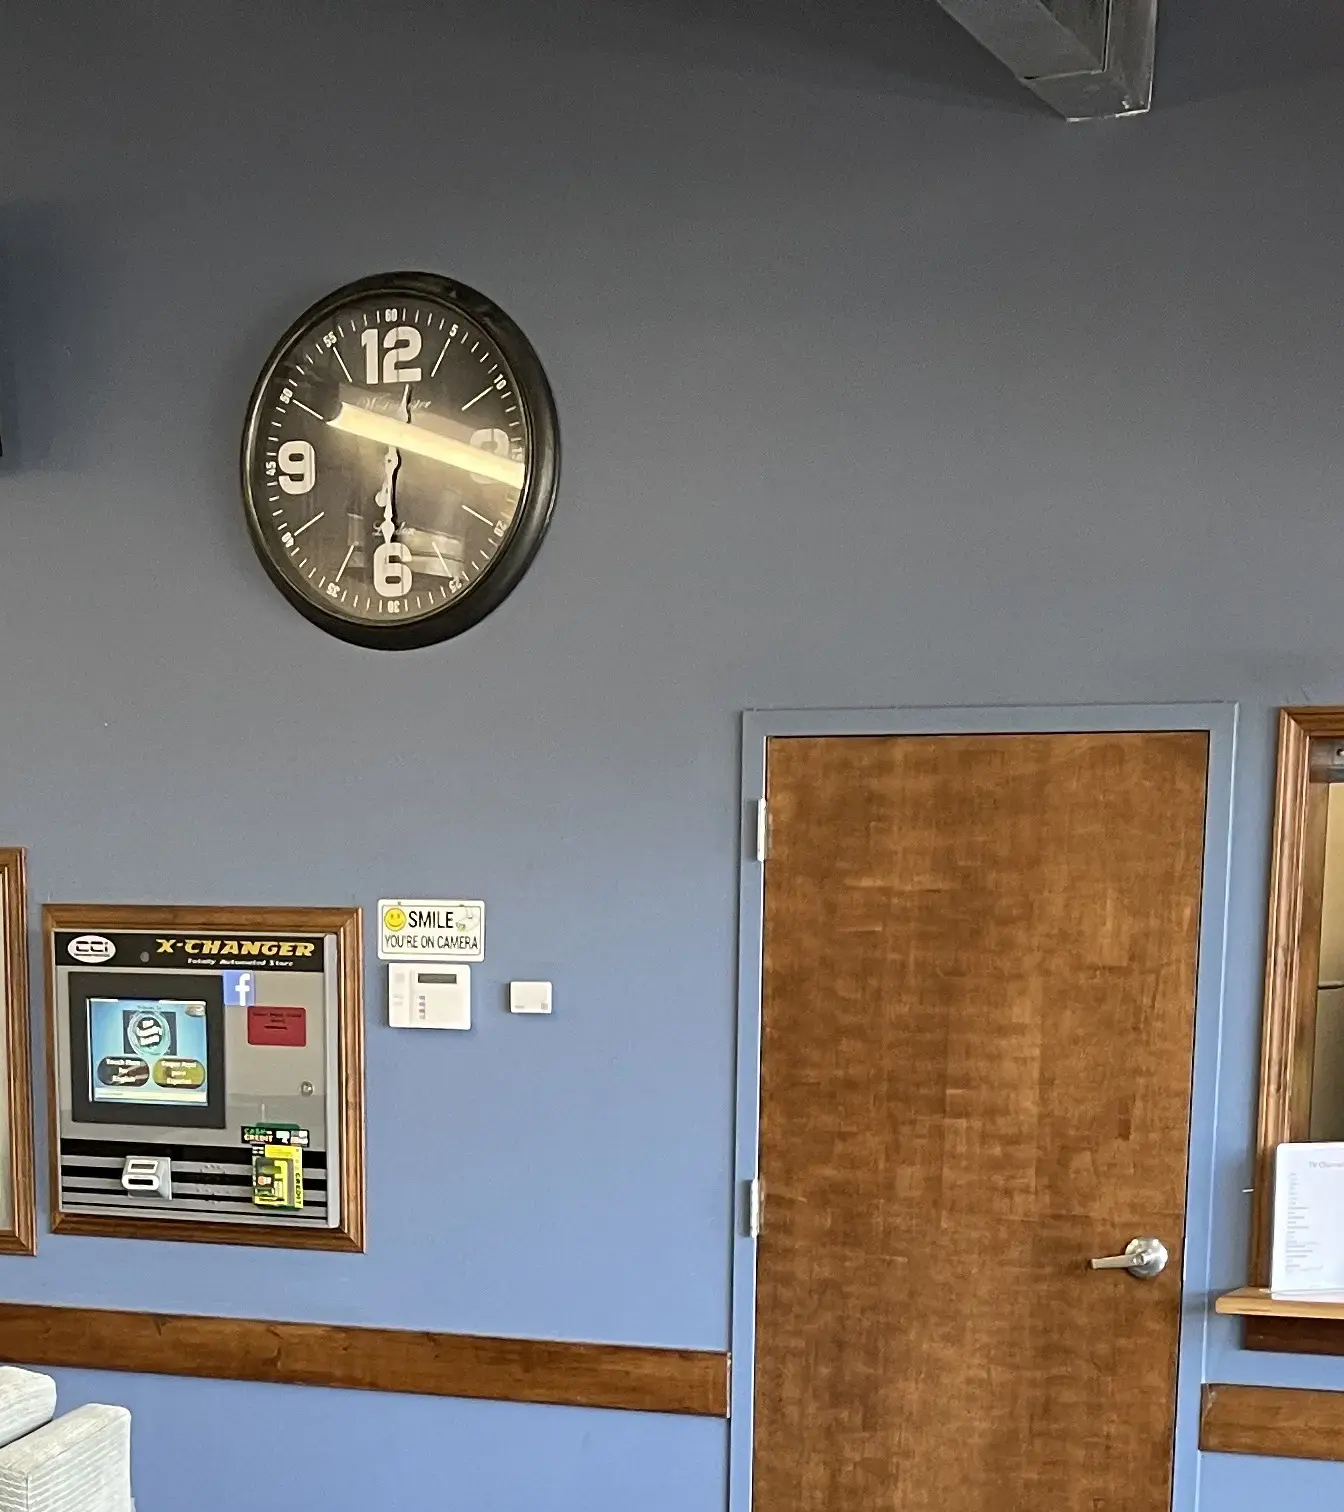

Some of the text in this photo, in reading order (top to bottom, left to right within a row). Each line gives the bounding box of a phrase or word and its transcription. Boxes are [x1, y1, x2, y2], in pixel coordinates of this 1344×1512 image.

[385, 309, 397, 322] 60
[450, 324, 459, 337] 5
[361, 326, 422, 385] 12
[278, 440, 316, 495] 9
[373, 542, 412, 597] 6
[408, 911, 454, 929] SMILE
[156, 939, 315, 957] X-CHANGER
[384, 934, 478, 950] YOU'RE ON CAMERA
